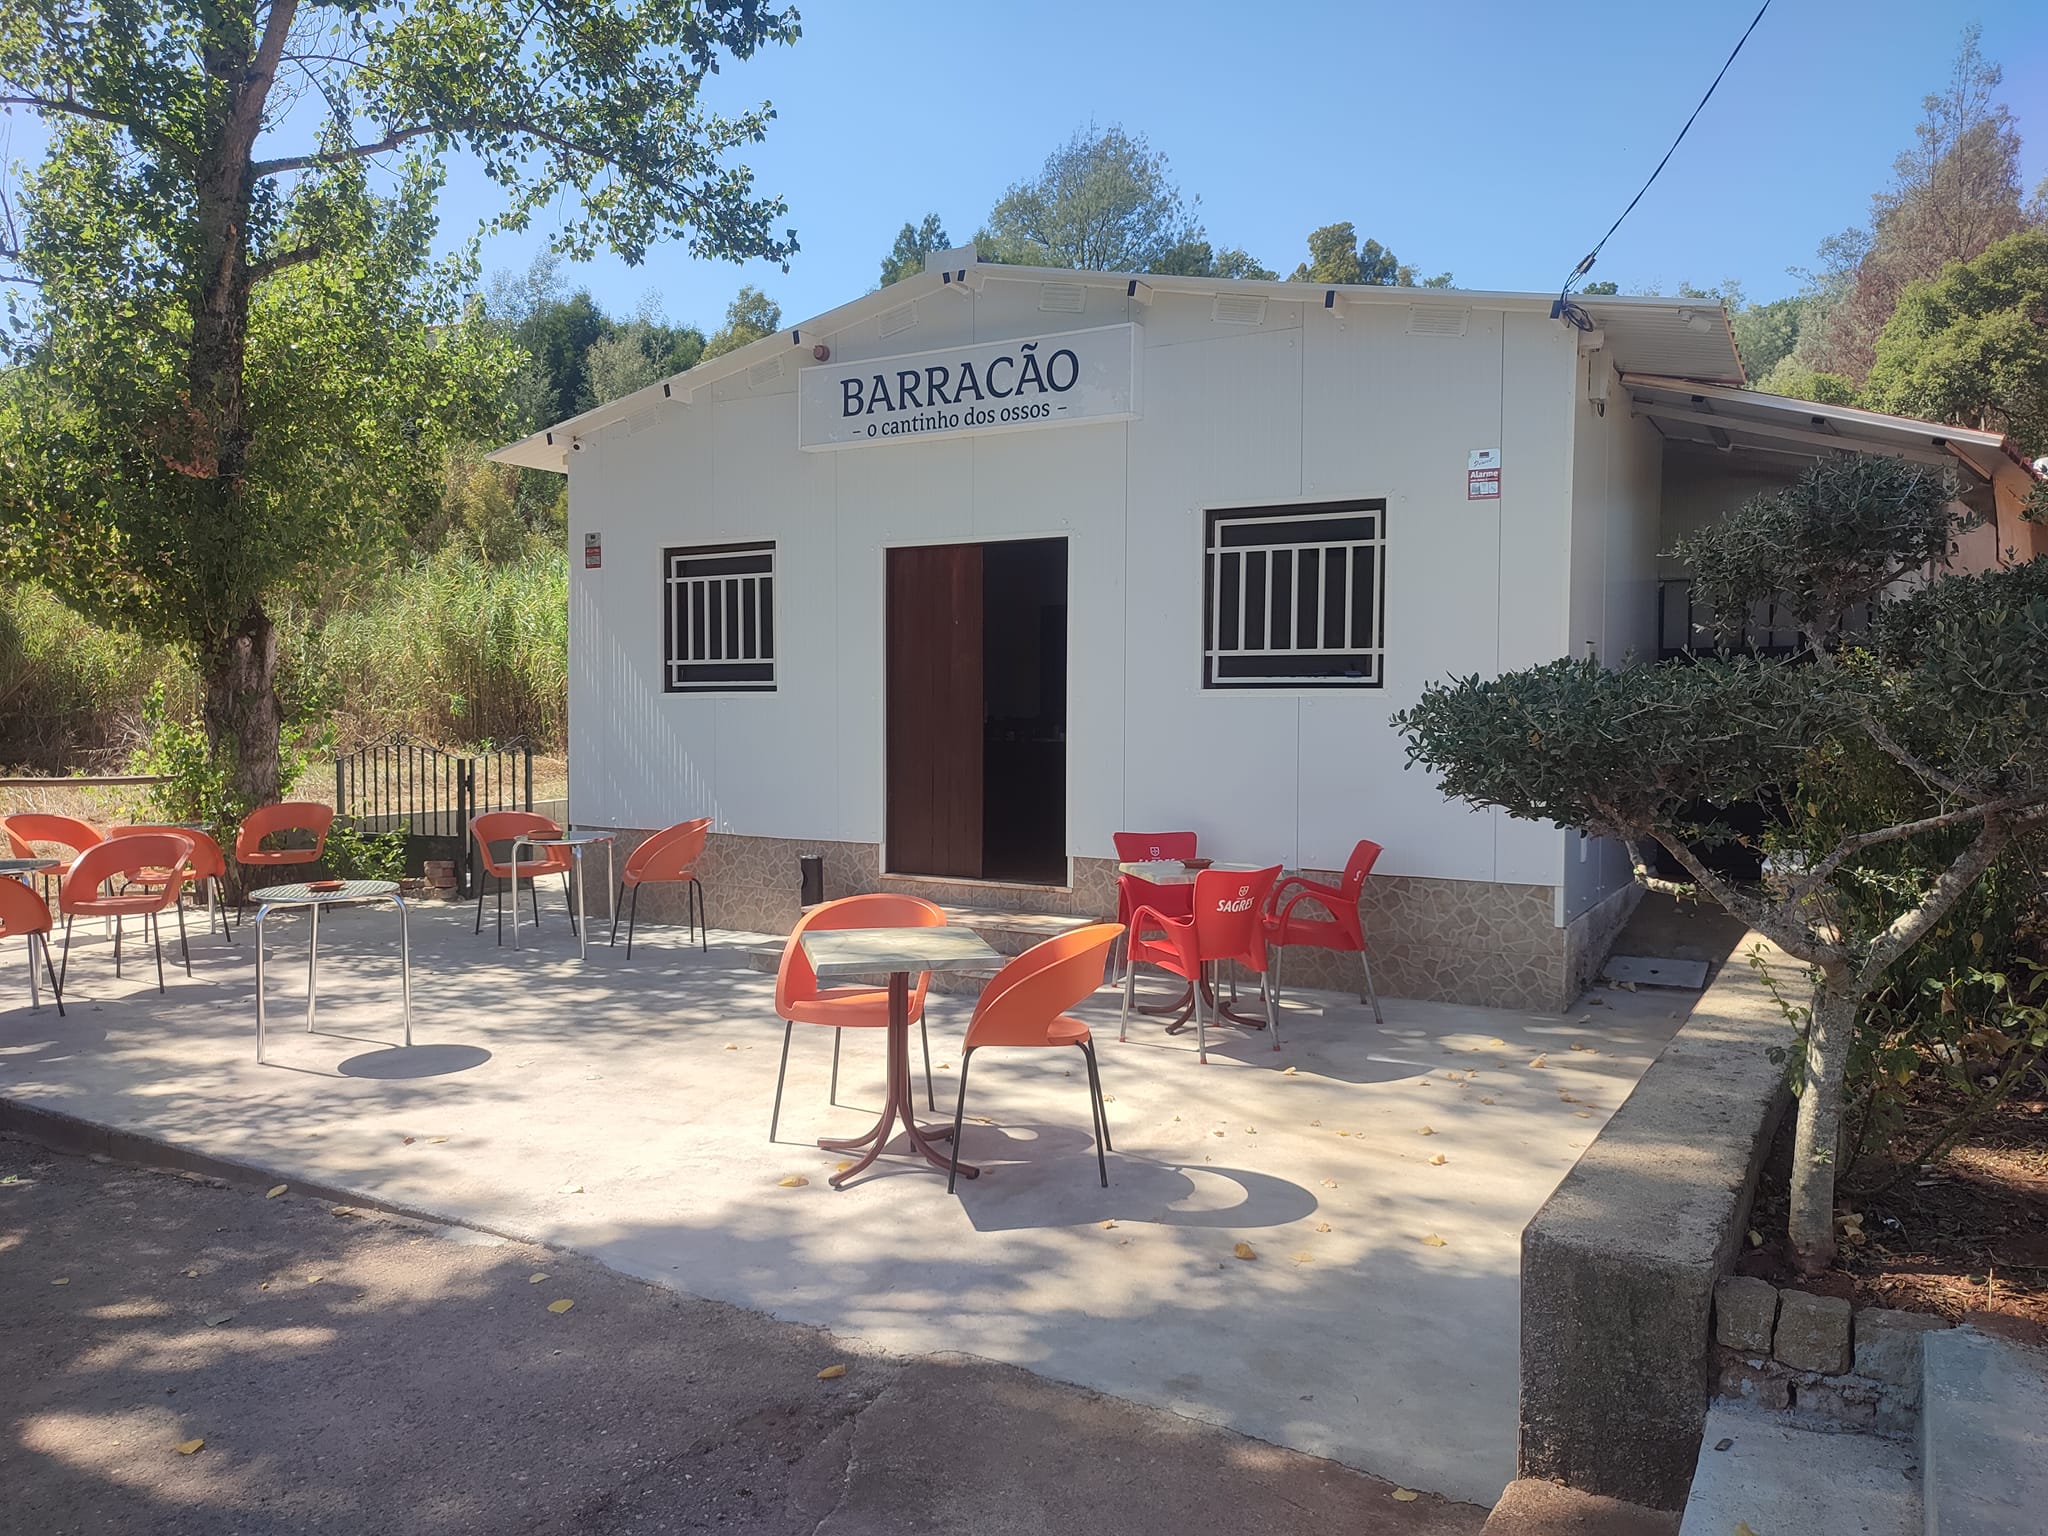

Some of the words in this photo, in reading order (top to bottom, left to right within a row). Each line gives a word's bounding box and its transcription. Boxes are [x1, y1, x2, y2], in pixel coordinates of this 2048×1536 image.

[840, 342, 1079, 417] BARRACÃO
[867, 424, 877, 437] o
[881, 411, 959, 435] cantinho
[964, 406, 995, 426] dos
[1000, 403, 1050, 421] ossos
[1470, 470, 1499, 479] Alarme
